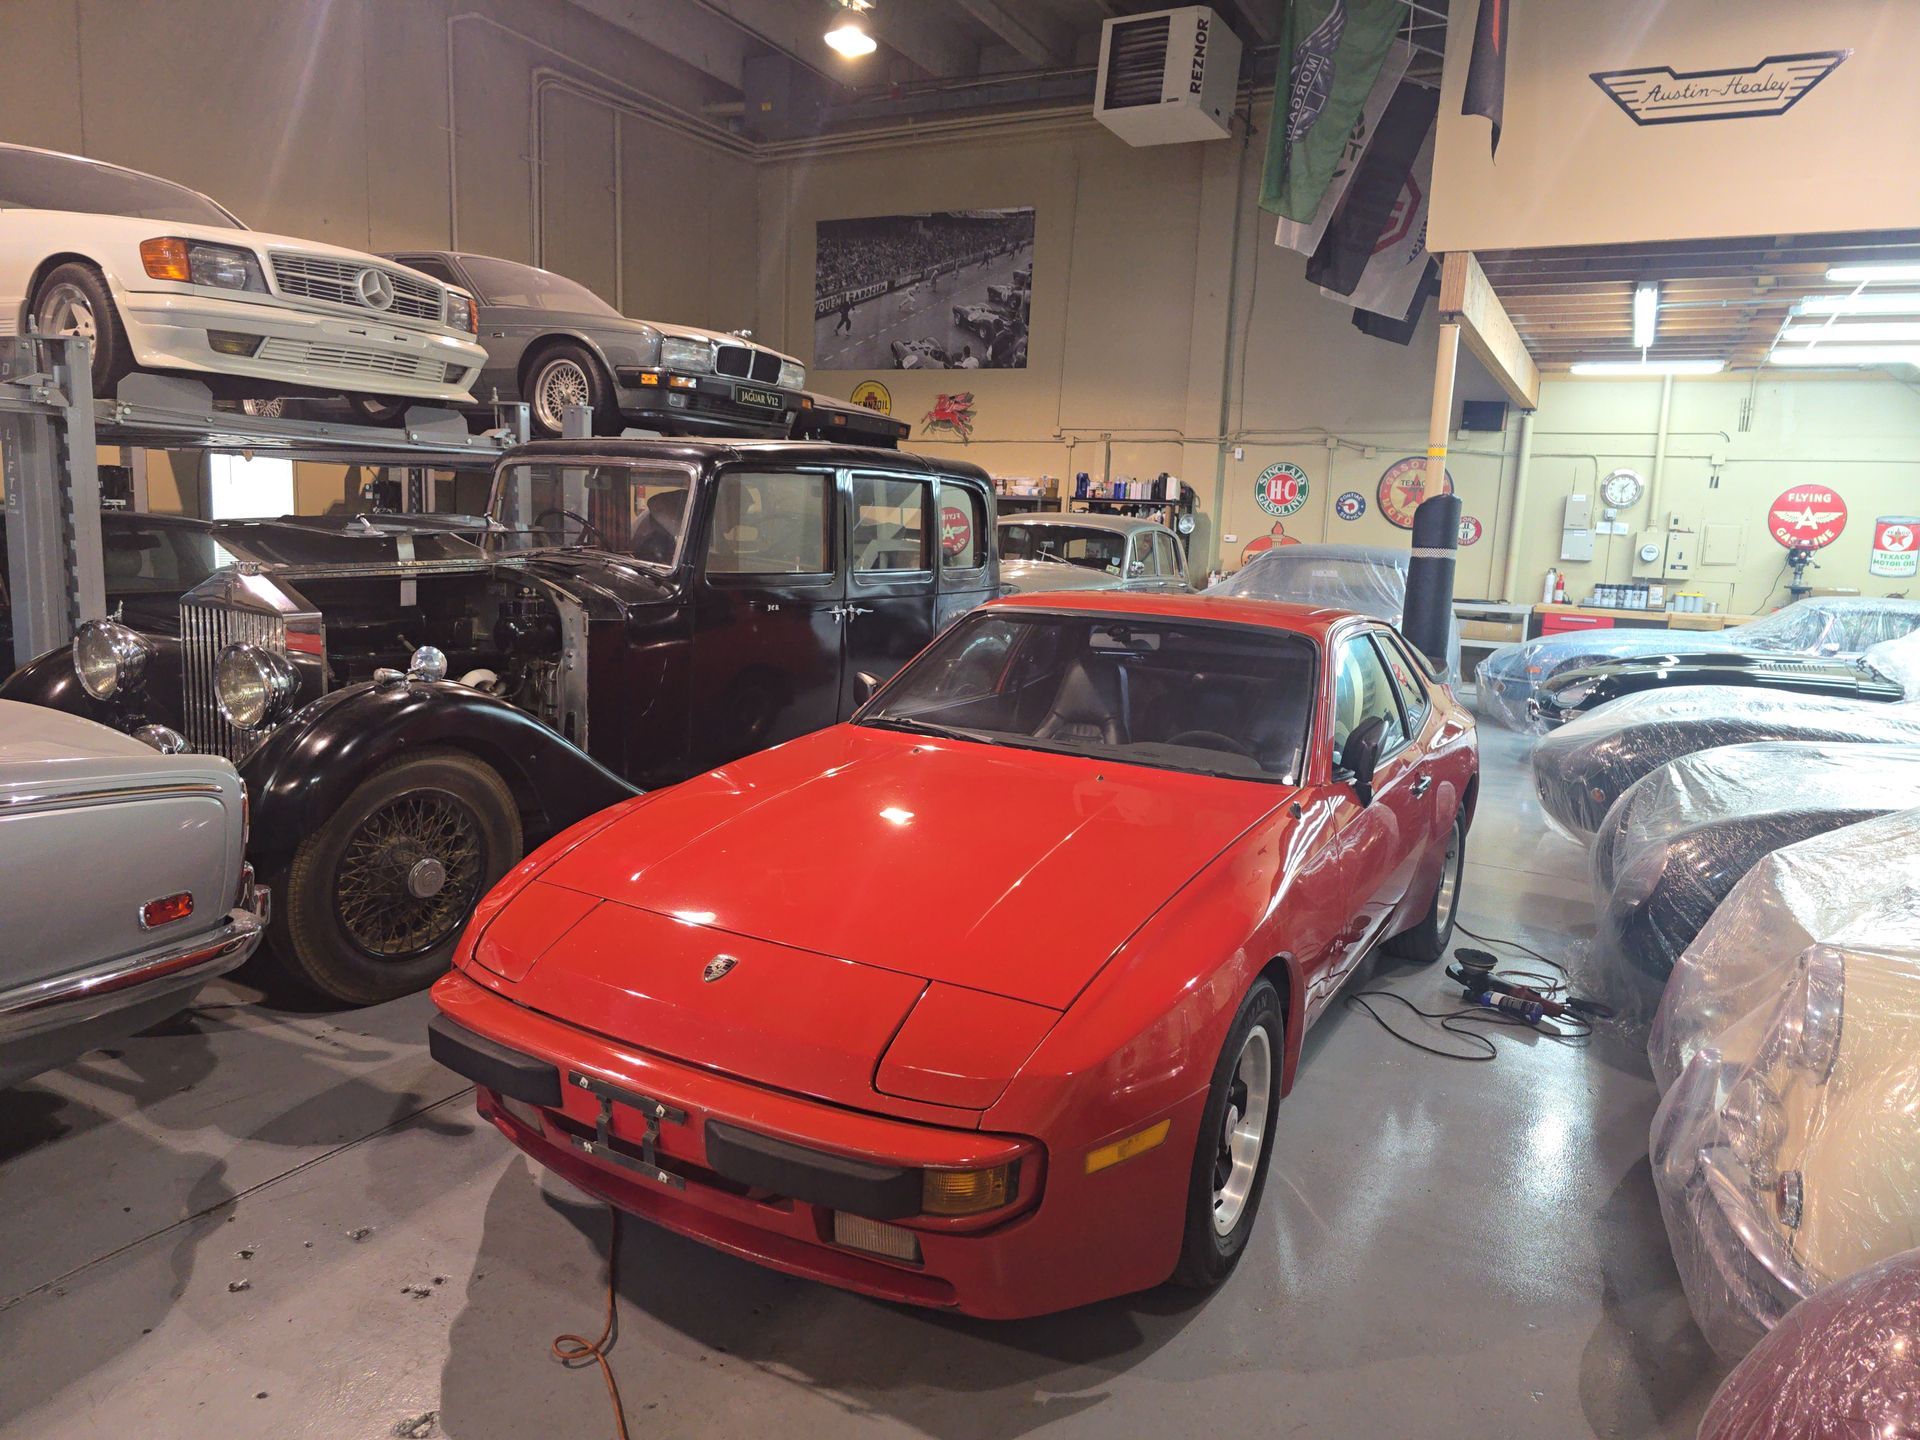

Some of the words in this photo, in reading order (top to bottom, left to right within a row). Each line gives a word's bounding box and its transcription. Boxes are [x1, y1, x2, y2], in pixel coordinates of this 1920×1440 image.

[1189, 18, 1209, 94] REZNOR
[741, 391, 765, 405] JAGUAR
[766, 393, 779, 406] V12
[6, 428, 17, 506] LIFTS
[1259, 464, 1306, 487] SINCLAIR
[1259, 493, 1305, 514] GASOLINE
[1788, 493, 1832, 503] FLYING
[1382, 498, 1412, 525] MOTO
[1776, 528, 1835, 545] GASINE
[1873, 558, 1901, 567] MOTOR
[1902, 560, 1916, 568] OIL
